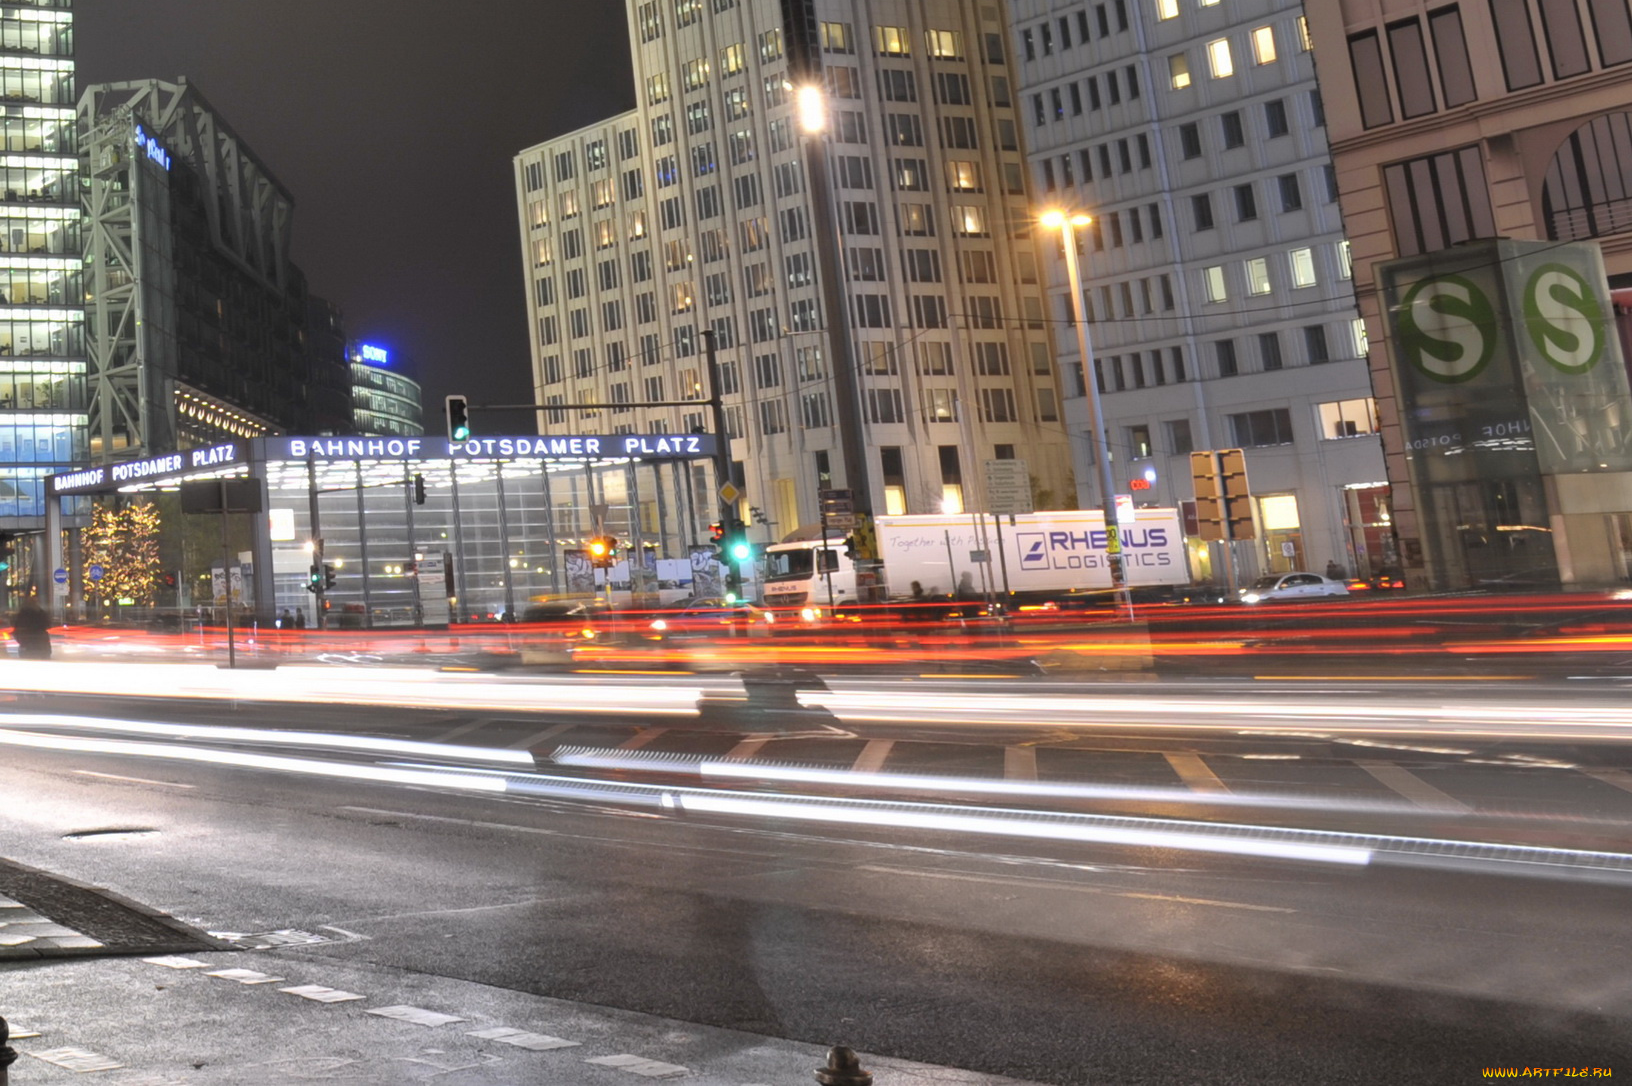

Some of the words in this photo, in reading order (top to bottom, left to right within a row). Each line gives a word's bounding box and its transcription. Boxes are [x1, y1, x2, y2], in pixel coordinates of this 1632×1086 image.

[1411, 281, 1484, 376] S
[1534, 271, 1595, 367] S
[289, 439, 422, 457] BAHNHOF
[448, 438, 600, 456] POTSDAMER
[625, 436, 701, 454] PLATZ
[54, 468, 104, 491] BAHNHOF
[112, 454, 182, 481] POTSDAMER
[192, 444, 234, 467] PLATZ
[889, 536, 935, 552] Together
[939, 536, 964, 546] wth
[1053, 552, 1171, 570] LOGITICS
